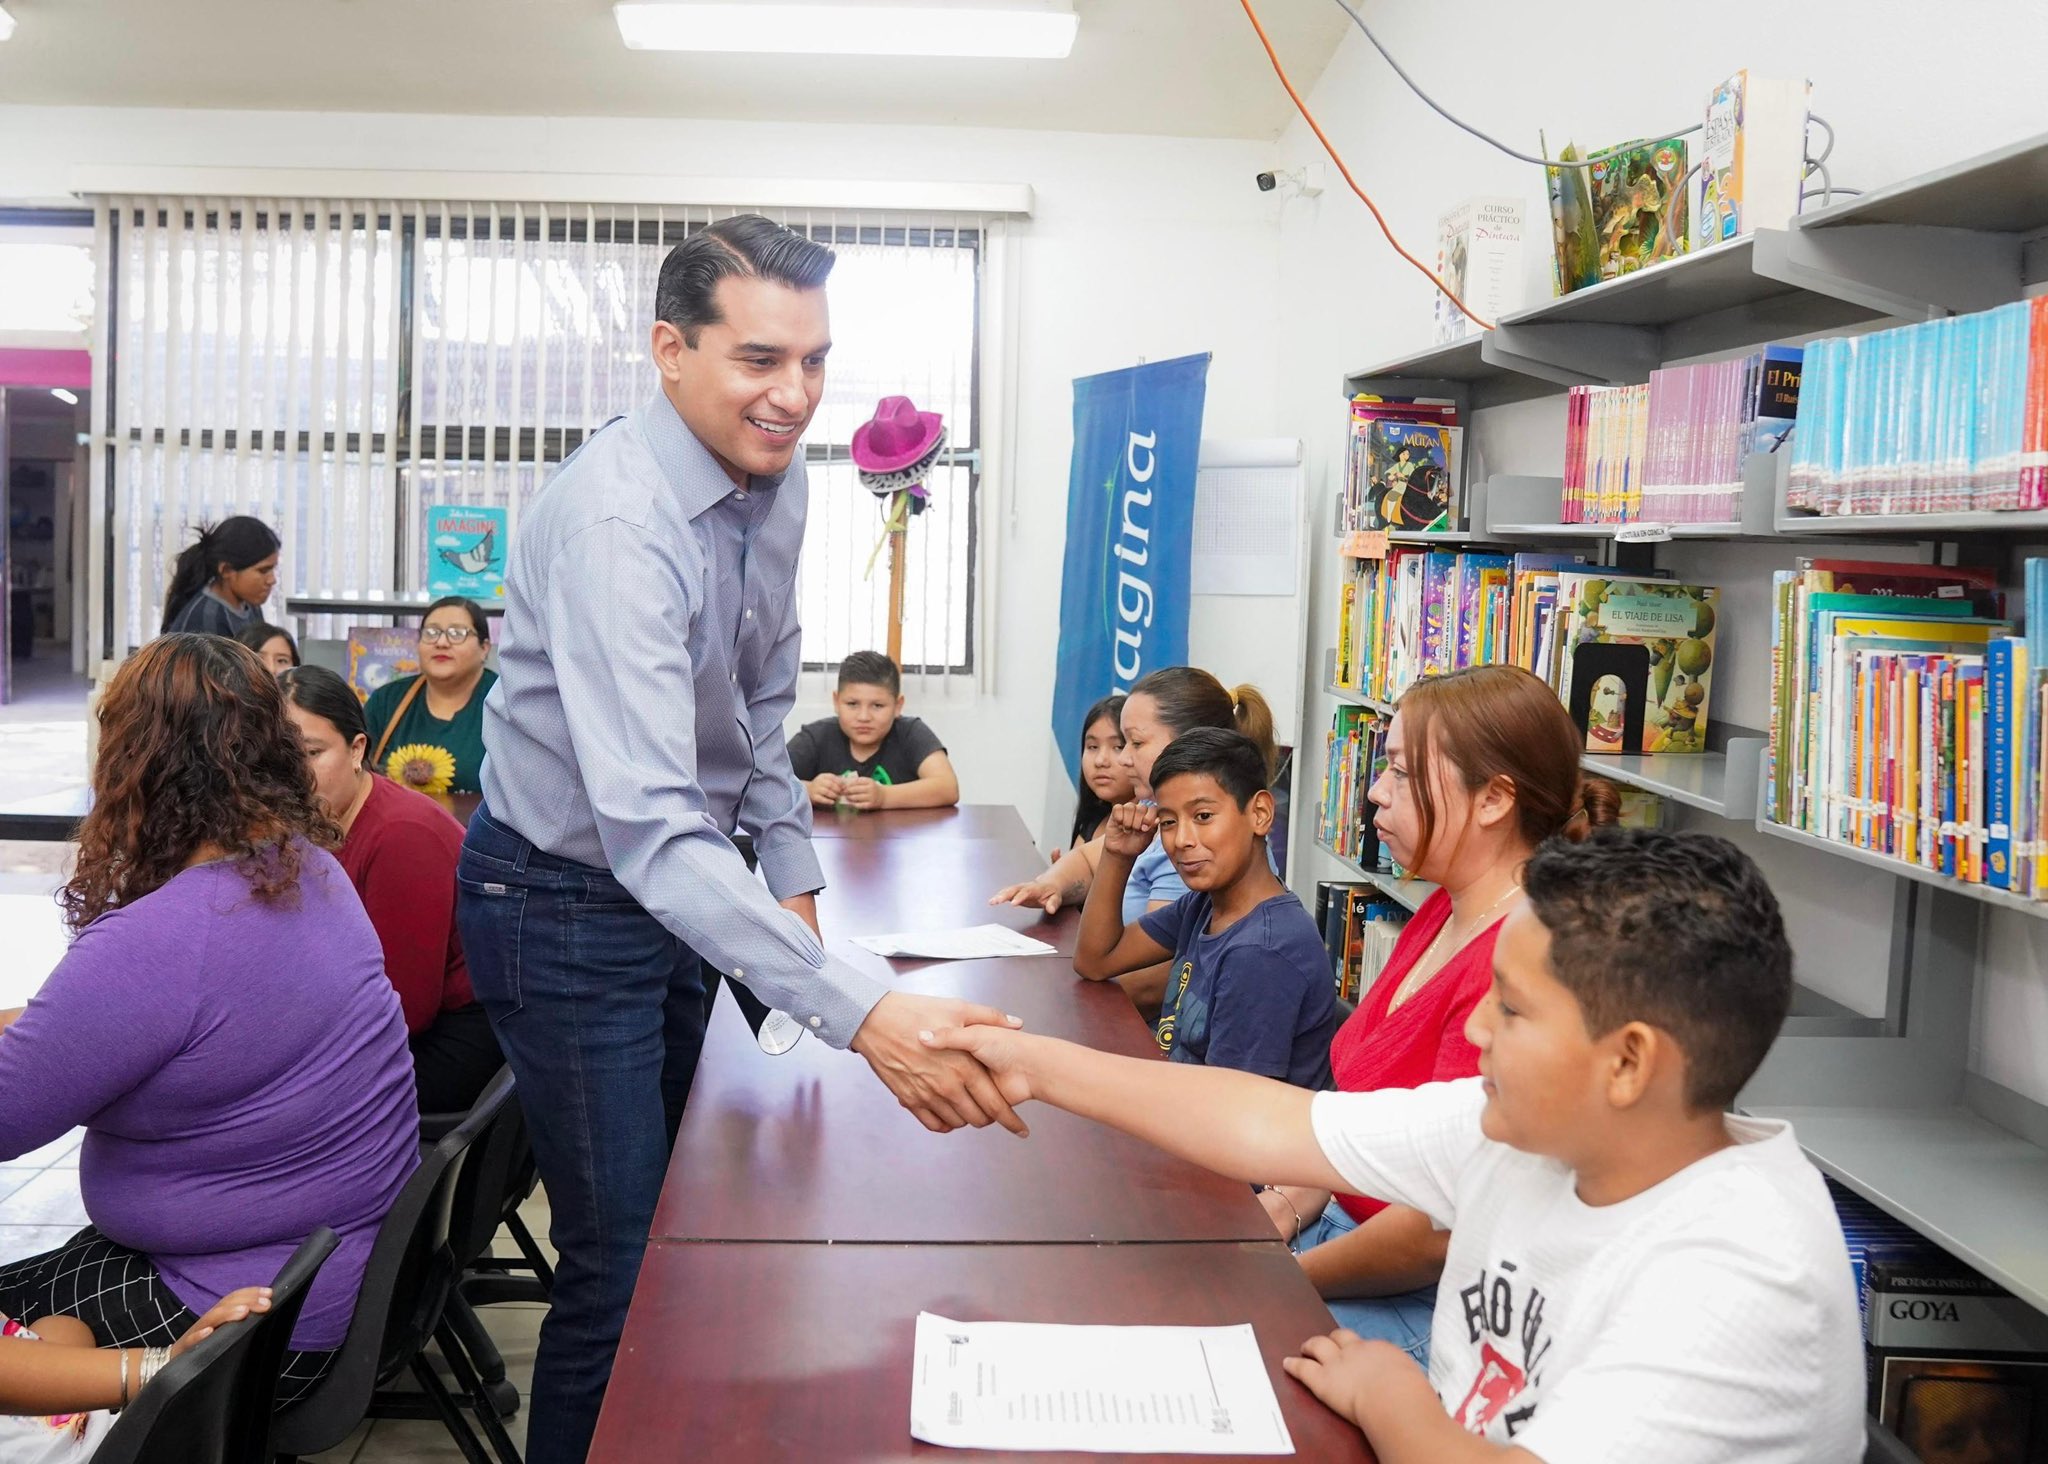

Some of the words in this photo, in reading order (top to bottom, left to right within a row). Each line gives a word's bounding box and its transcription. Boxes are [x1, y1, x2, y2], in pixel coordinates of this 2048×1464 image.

[1484, 204, 1514, 214] CURSO
[1477, 214, 1520, 225] PRÁCTICO
[1475, 227, 1520, 242] Pintura
[1767, 370, 1780, 386] El
[1782, 371, 1801, 388] Pri
[1402, 433, 1440, 449] MULAN
[437, 519, 497, 534] IMAGINE
[1113, 430, 1157, 697] agina
[1611, 610, 1622, 620] EL
[1624, 611, 1648, 621] VIAJE
[1650, 612, 1662, 622] DE
[1664, 613, 1684, 623] LISA
[1995, 652, 2004, 665] EL
[1995, 672, 2005, 723] TESORO
[1995, 728, 2004, 744] DE
[1994, 748, 2004, 774] LOS
[1889, 1299, 1960, 1322] GOYA
